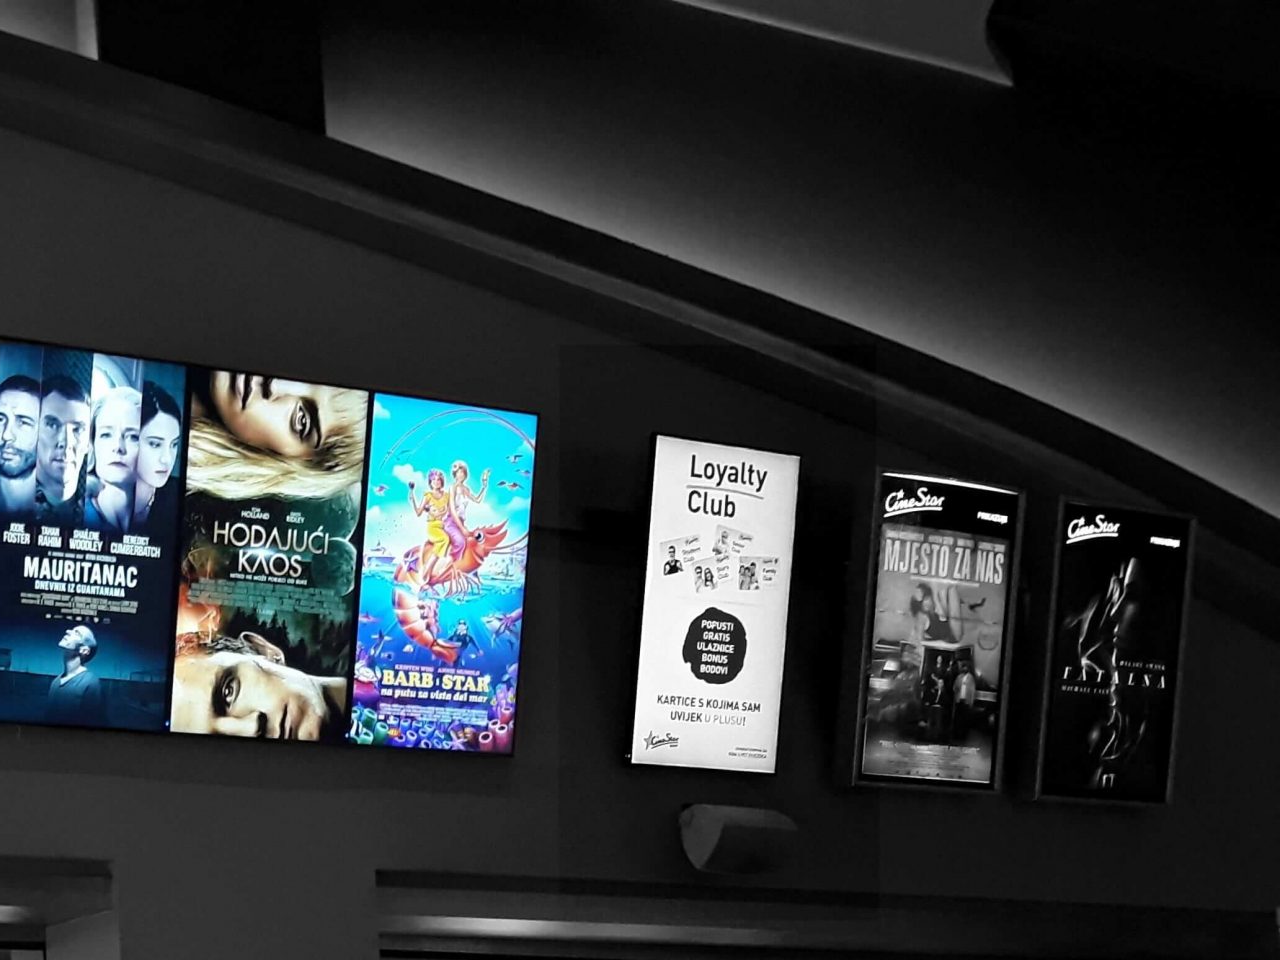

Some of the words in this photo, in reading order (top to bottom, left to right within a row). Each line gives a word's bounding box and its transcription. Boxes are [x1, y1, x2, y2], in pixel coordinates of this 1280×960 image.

[690, 454, 768, 493] Loyalty
[687, 490, 736, 518] Club
[3, 531, 31, 545] FOSTER
[38, 535, 61, 548] RAHIM
[213, 521, 329, 555] HODAJUĆI
[238, 550, 302, 577] KAOS
[884, 538, 949, 579] MJESTO
[953, 544, 971, 581] ZA
[975, 548, 1005, 585] NAS
[24, 556, 137, 588] MAURITANAC
[35, 580, 66, 592] DNEVNIK
[67, 582, 75, 593] IZ
[701, 620, 734, 632] POPUSTI
[703, 631, 730, 642] GRATIS
[697, 641, 735, 654] ULAZNICE
[701, 653, 728, 664] BONUS
[700, 664, 728, 675] BODOVI
[382, 669, 434, 688] BARB
[442, 674, 492, 692] STAR
[381, 688, 393, 696] na
[453, 692, 467, 702] del
[657, 694, 696, 707] KARTICE
[698, 698, 704, 707] S
[706, 700, 740, 711] KOJIMA
[741, 702, 761, 713] SAM
[670, 711, 702, 723] UVIJEK
[704, 715, 710, 723] U
[713, 714, 746, 727] PLUSU!
